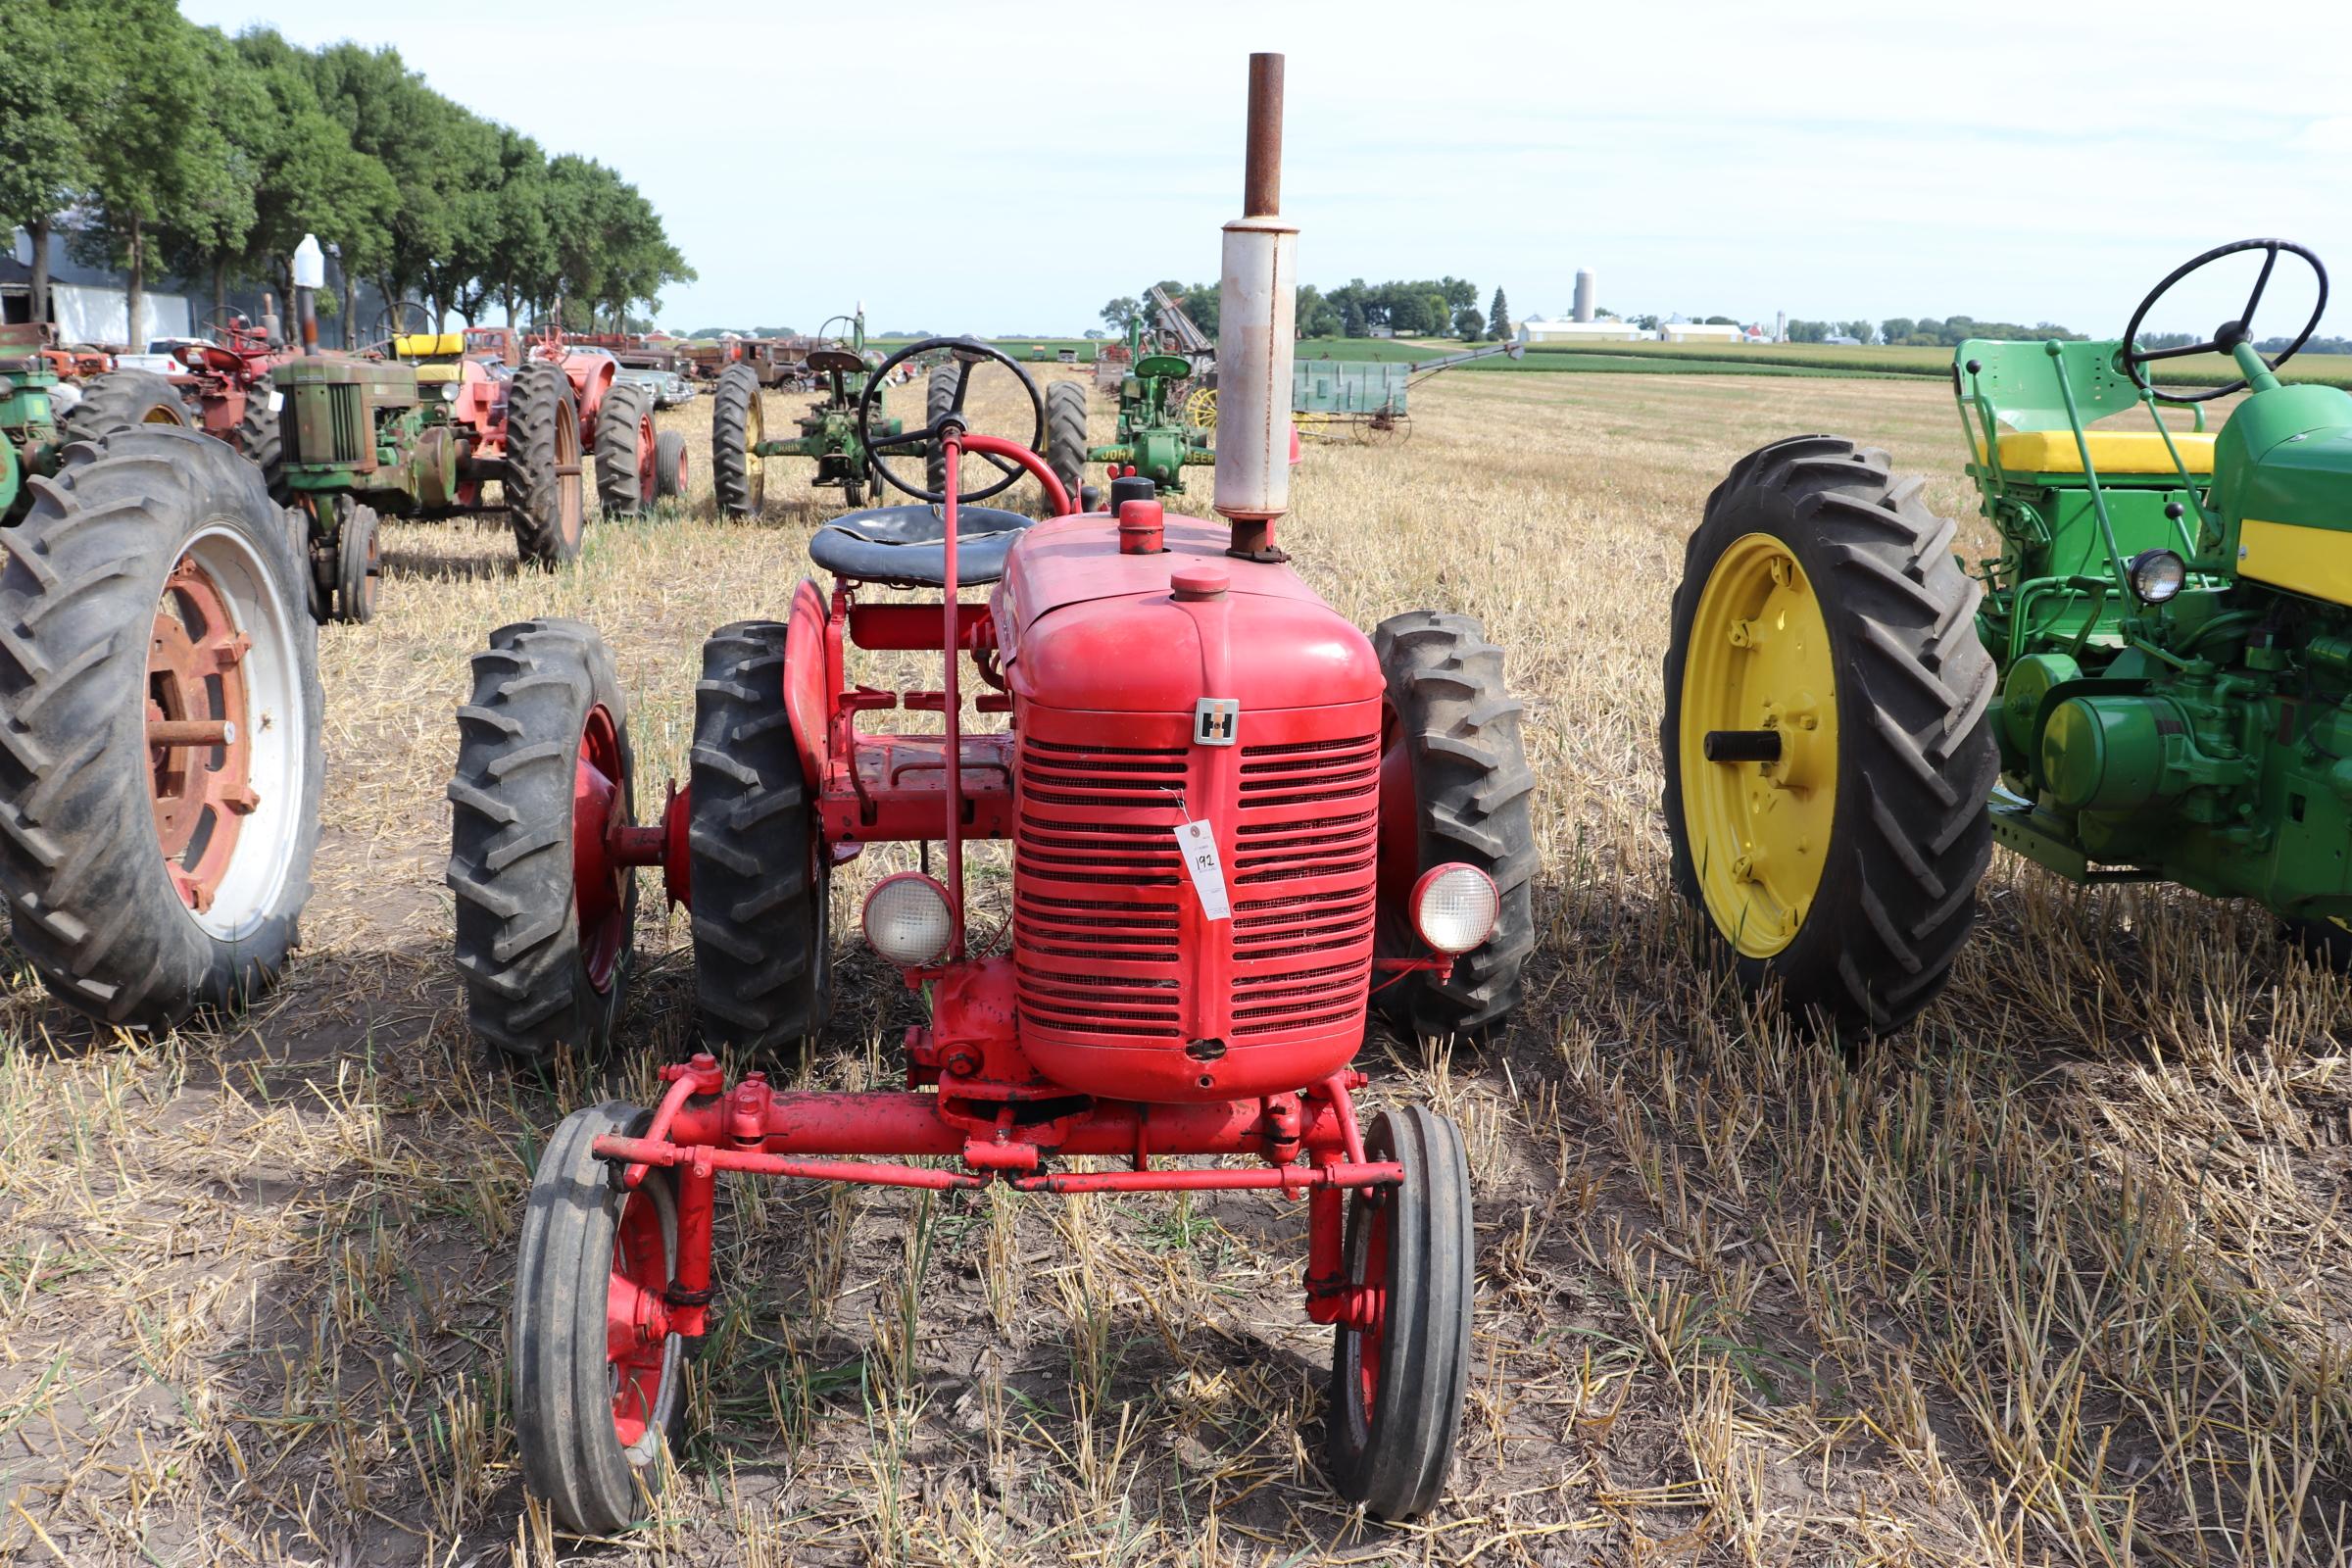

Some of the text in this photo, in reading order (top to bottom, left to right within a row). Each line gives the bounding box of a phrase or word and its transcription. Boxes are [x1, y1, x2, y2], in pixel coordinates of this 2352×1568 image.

[1101, 448, 1215, 464] JOHN DEER
[1195, 854, 1215, 871] 192
